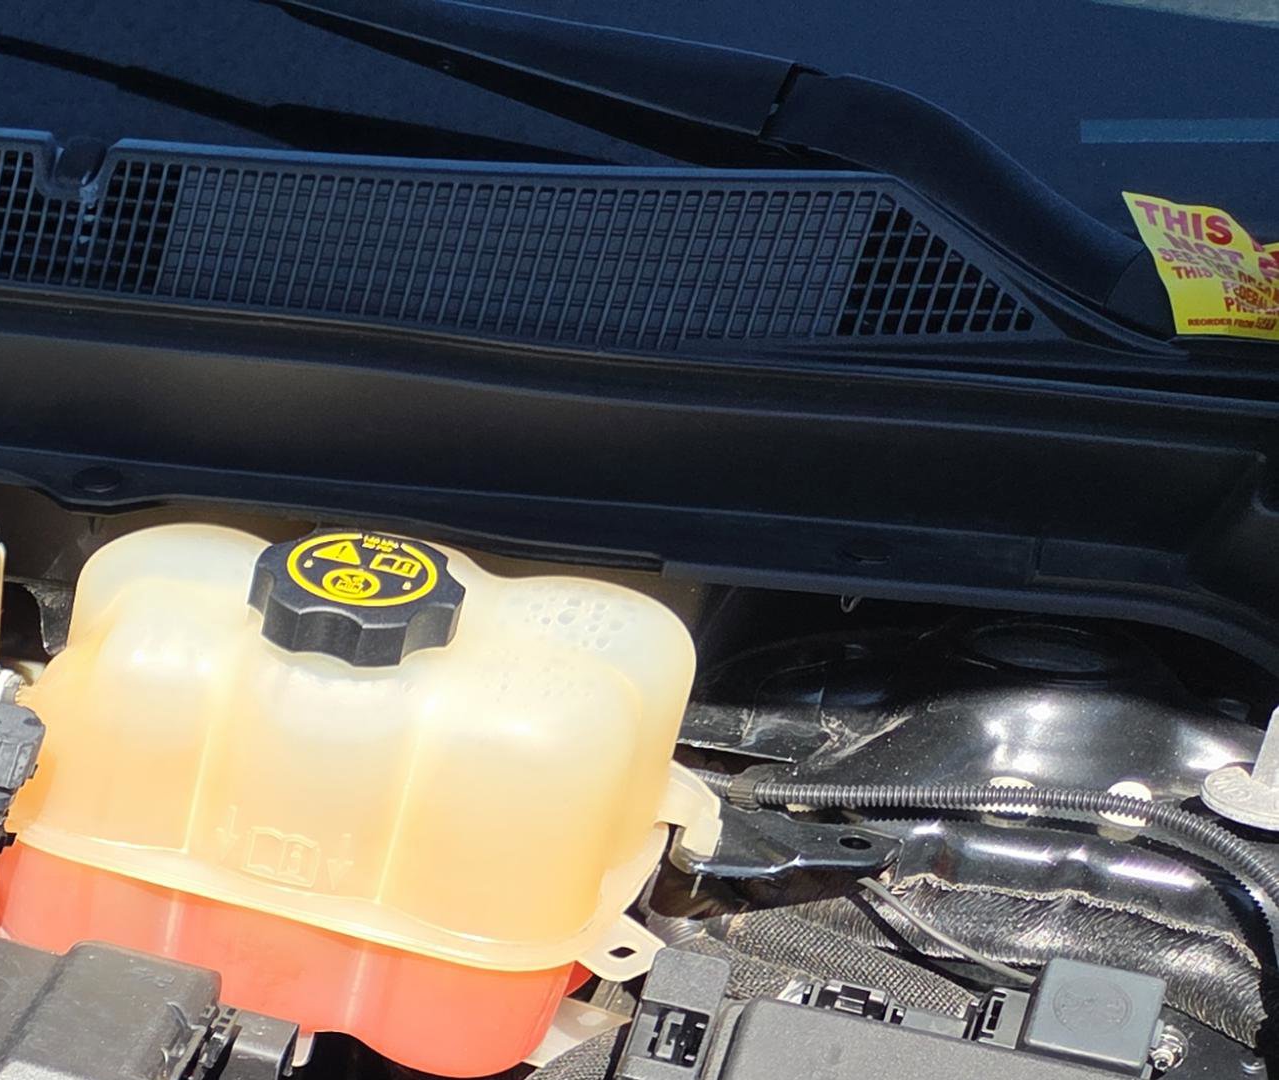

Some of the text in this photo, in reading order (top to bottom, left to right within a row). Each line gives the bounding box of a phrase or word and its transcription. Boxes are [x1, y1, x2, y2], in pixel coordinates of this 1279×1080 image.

[1135, 200, 1233, 245] THIS
[1164, 232, 1244, 265] NOT
[1188, 318, 1233, 327] REORDER
